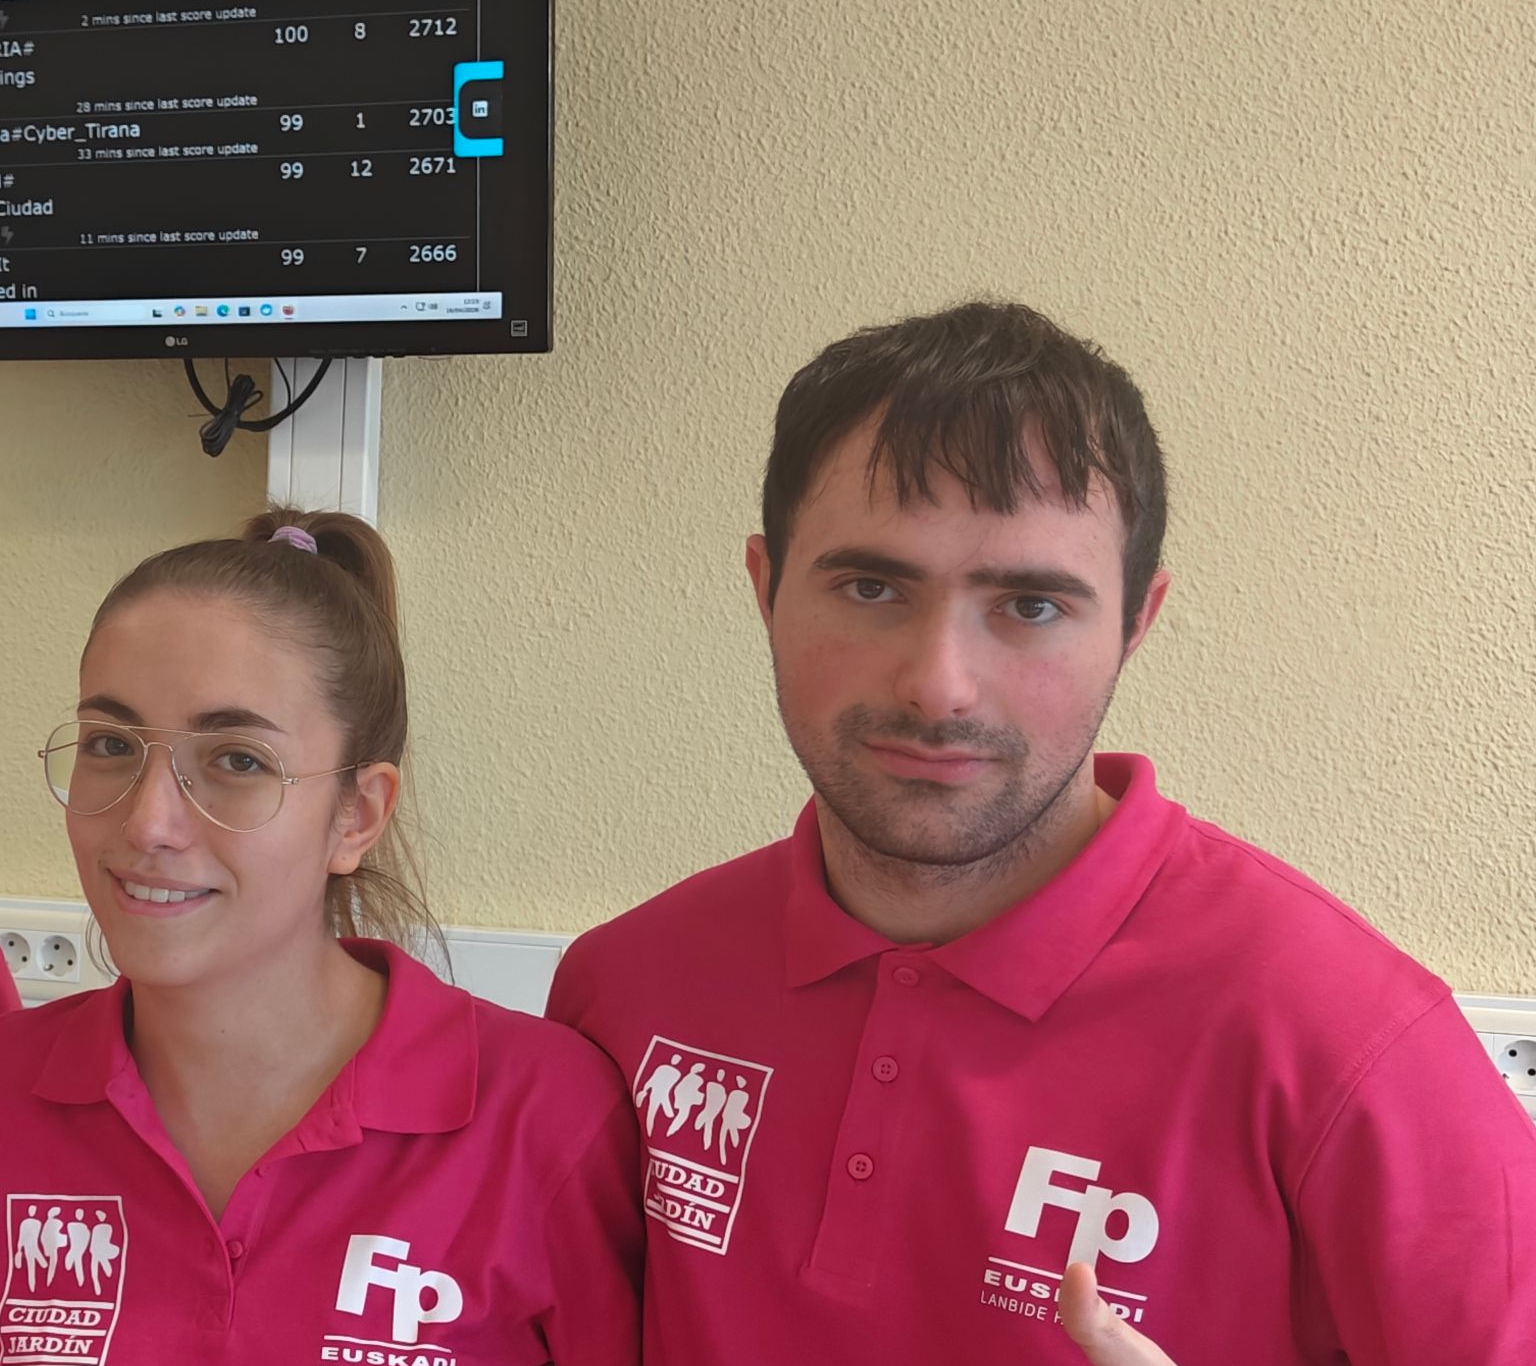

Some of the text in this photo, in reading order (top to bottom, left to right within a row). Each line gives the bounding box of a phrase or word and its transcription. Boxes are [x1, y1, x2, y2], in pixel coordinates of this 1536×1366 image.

[81, 7, 257, 27] 2 mins since last score update
[274, 17, 458, 44] 100 8 2712
[76, 94, 258, 114] 28 mins since last score update
[279, 108, 457, 132] 99 1 2703
[77, 142, 259, 160] 33 mins since last score update
[280, 157, 457, 179] 99 12 2671
[80, 228, 259, 245] 11 mins since last score update
[280, 244, 457, 266] 99 7 2666
[22, 283, 38, 299] in
[652, 1160, 725, 1198] UDAD
[664, 1199, 716, 1231] DÍN
[1004, 1145, 1160, 1271] Fp
[335, 1234, 464, 1343] Fp
[984, 1269, 1144, 1323] EUSDI
[980, 1290, 1048, 1321] LANBIDE
[8, 1307, 101, 1327] CIUDAD
[7, 1335, 94, 1355] JARDÍN
